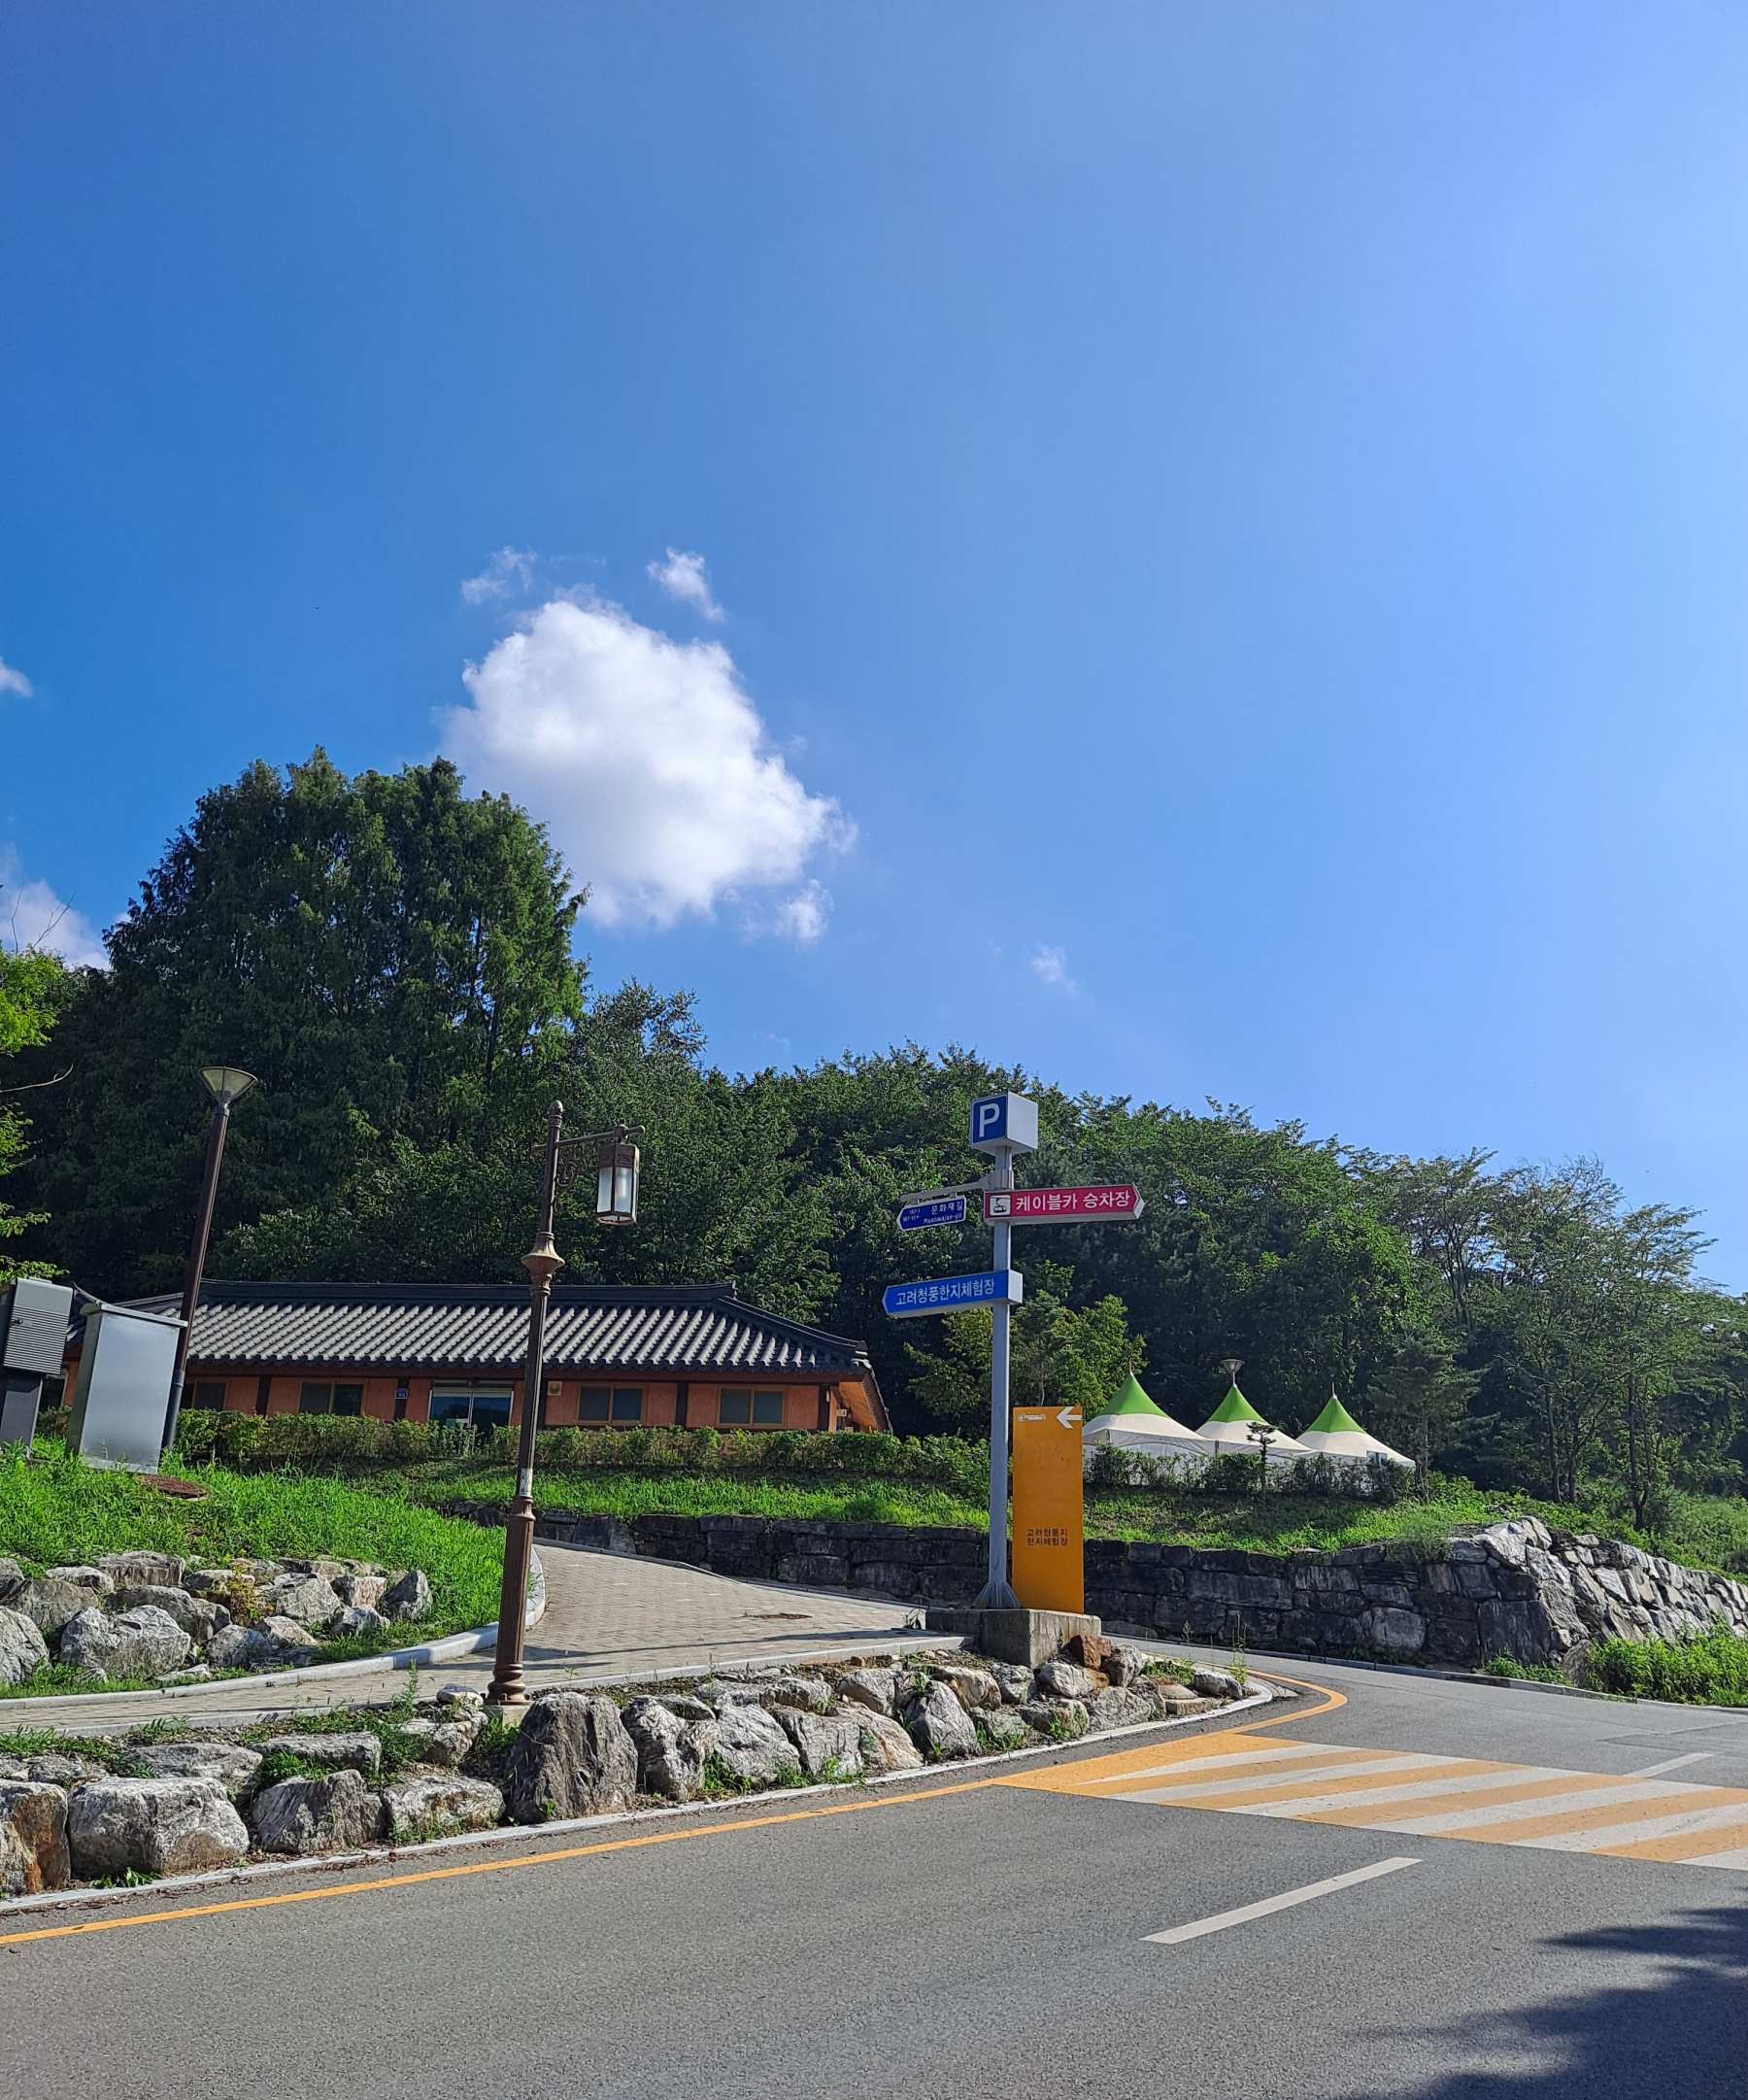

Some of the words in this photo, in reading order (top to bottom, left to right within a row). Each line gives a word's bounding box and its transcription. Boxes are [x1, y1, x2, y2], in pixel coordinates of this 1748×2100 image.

[979, 1102, 1000, 1137] P
[931, 1201, 963, 1215] 문화재길
[1016, 1193, 1078, 1212] 케이블카
[1083, 1190, 1130, 1209] 승차장
[895, 1279, 995, 1305] 고려청풍한지체험장
